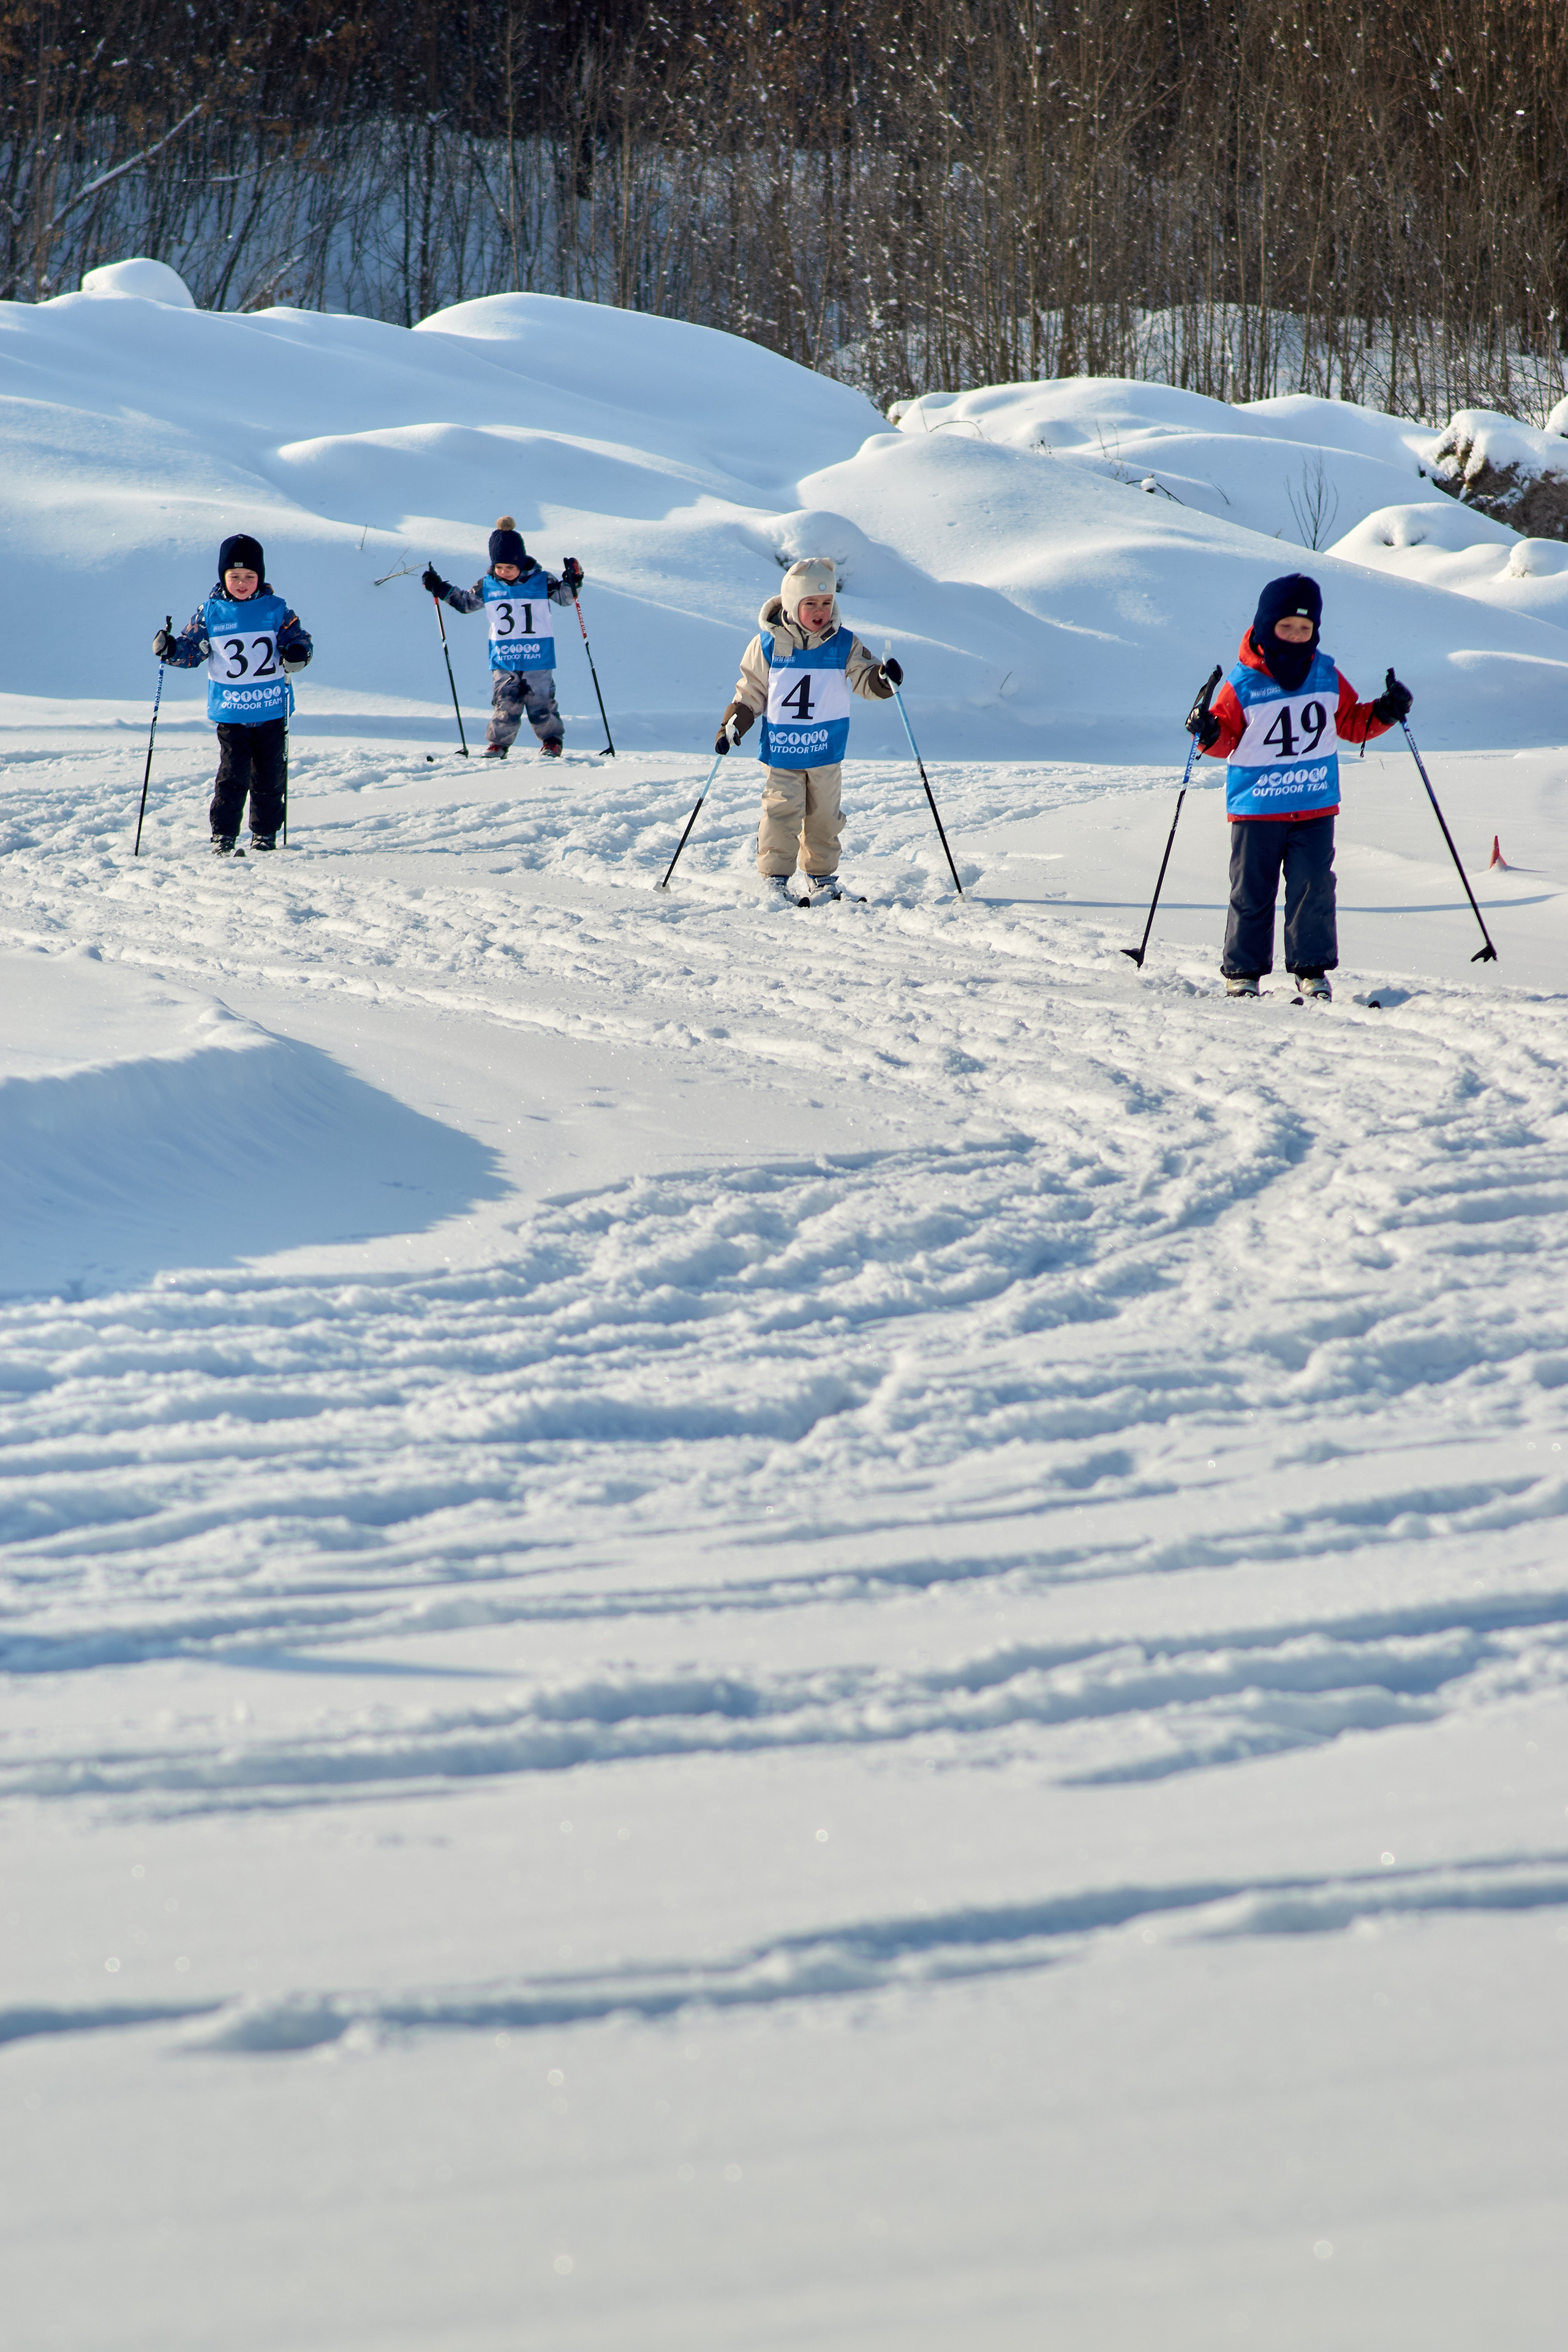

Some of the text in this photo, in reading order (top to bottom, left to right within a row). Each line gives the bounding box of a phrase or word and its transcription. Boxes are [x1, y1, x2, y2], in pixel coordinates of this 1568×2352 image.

[496, 603, 536, 635] 31
[224, 636, 276, 678] 32
[154, 674, 163, 707] NORDWAY
[221, 696, 283, 710] OUTDOOR TEAM
[781, 674, 815, 720] 4
[1250, 685, 1282, 698] World Class
[1263, 701, 1327, 758] 49
[810, 742, 827, 752] TEAM
[1186, 735, 1200, 777] NORDWAY
[1252, 783, 1304, 797] OUTDOOR
